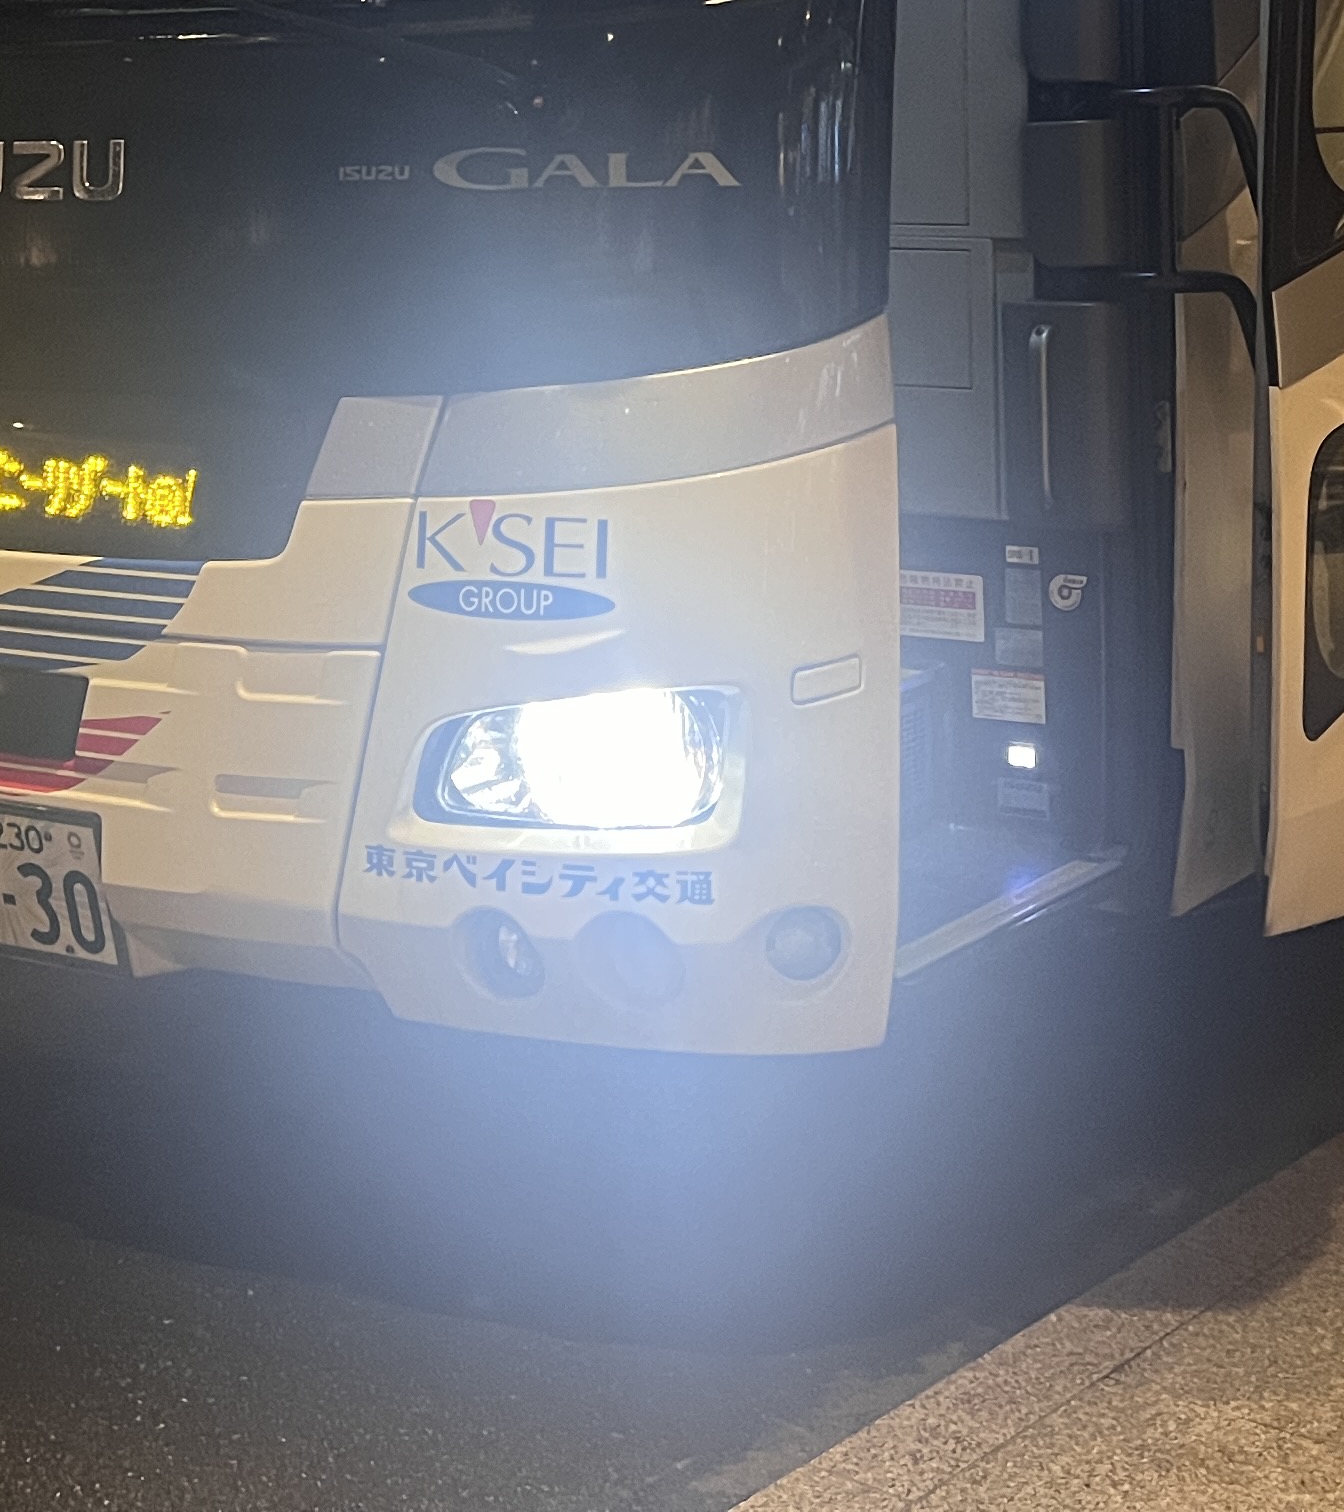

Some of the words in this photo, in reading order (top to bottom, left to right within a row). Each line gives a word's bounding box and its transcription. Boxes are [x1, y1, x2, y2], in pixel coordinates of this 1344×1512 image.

[339, 165, 411, 181] ISUZU
[433, 146, 743, 190] GALA
[458, 585, 554, 617] GROUP
[362, 843, 717, 906] 東京ベイシティ交通
